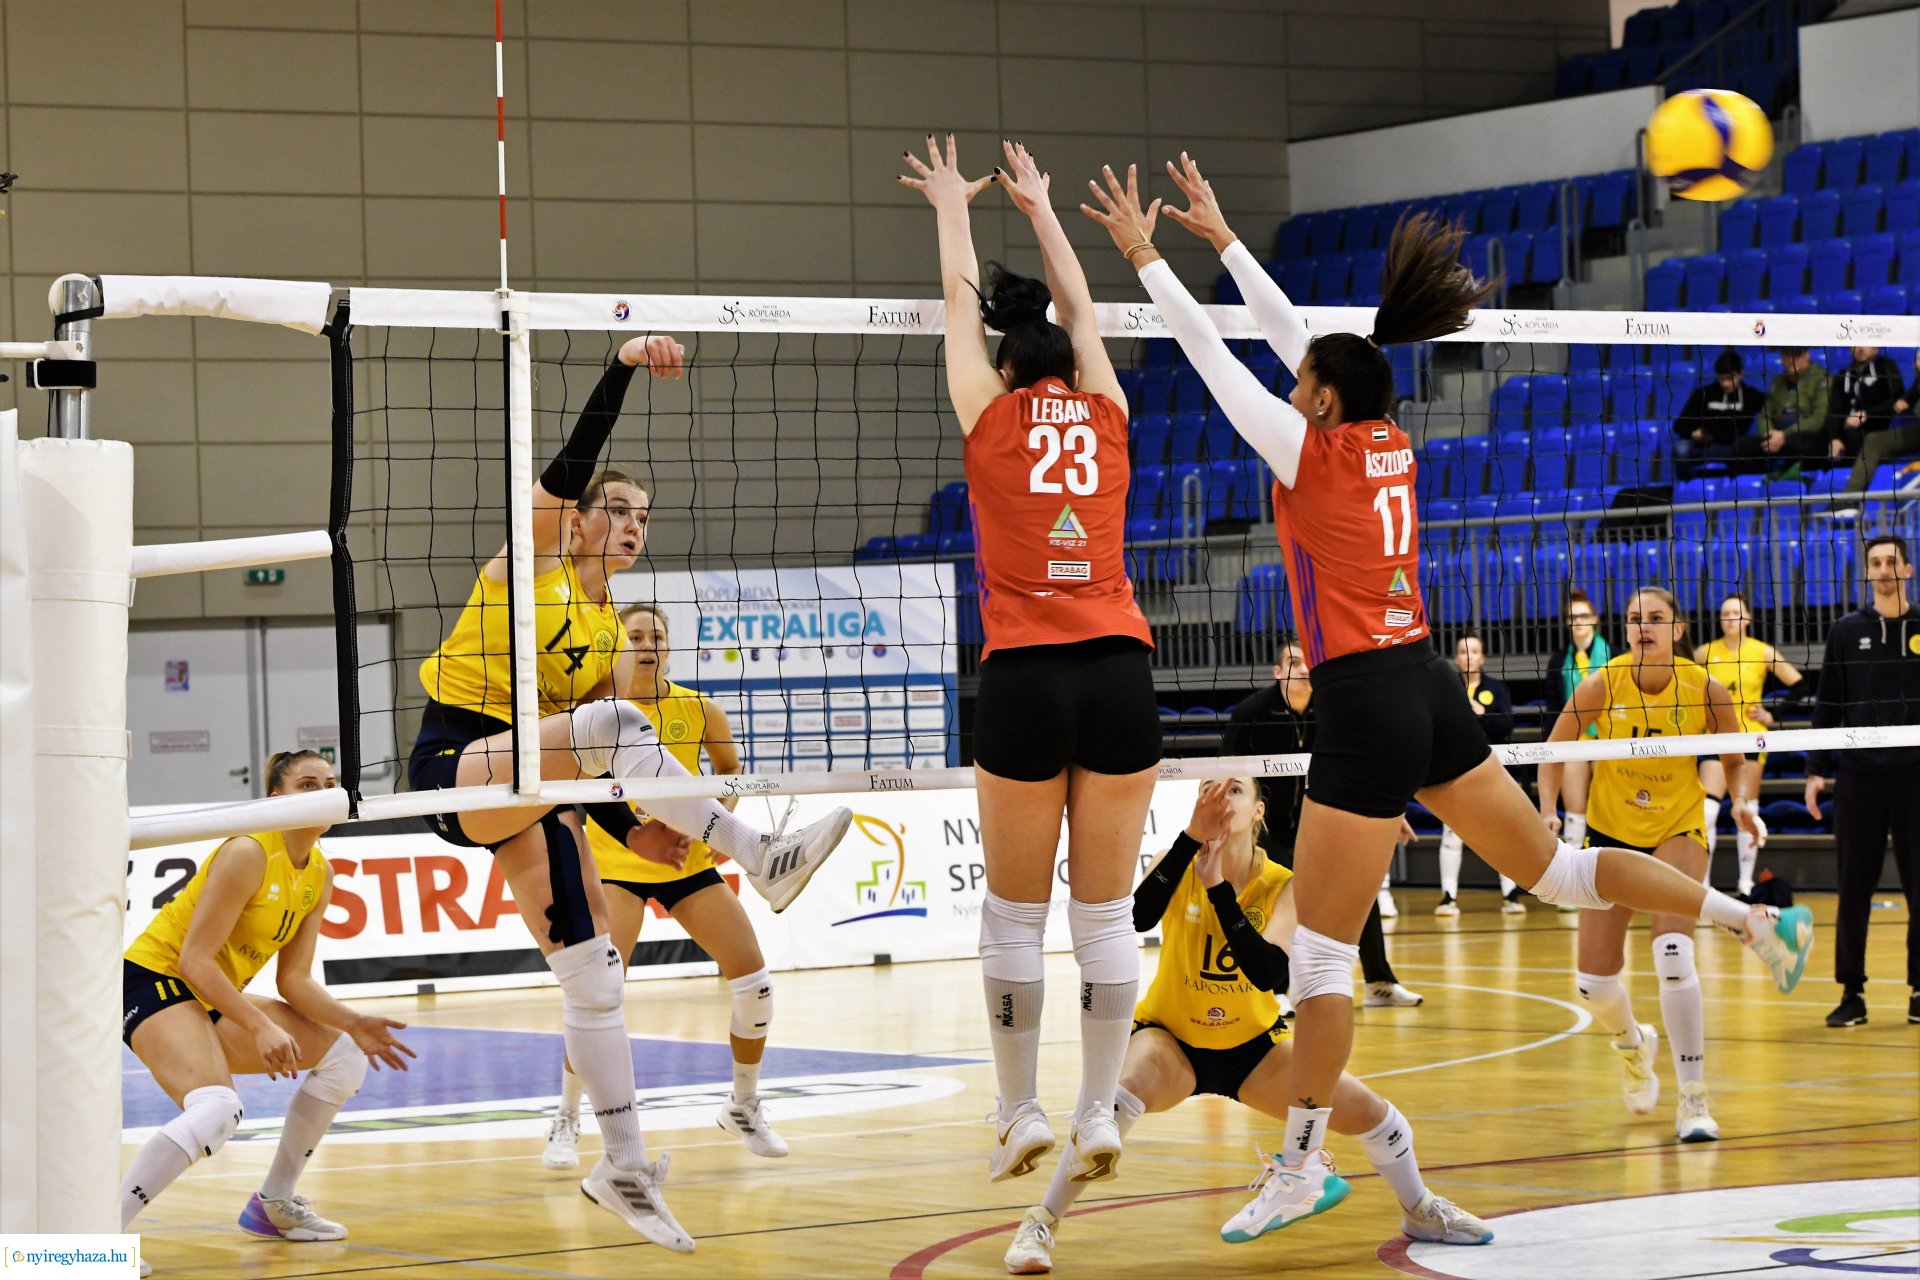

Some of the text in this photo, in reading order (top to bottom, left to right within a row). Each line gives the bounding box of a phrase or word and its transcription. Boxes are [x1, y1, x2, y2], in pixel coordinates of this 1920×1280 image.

[868, 305, 921, 324] FATUM
[1626, 318, 1671, 335] FATUM
[1032, 397, 1091, 424] LEBAN
[1028, 424, 1099, 496] 23
[1373, 484, 1413, 557] 17
[1050, 566, 1088, 574] STRABAG
[697, 611, 886, 642] EXTRALIGA
[545, 617, 591, 676] 14
[869, 774, 915, 791] FATUM
[1263, 759, 1304, 775] FATUM
[271, 909, 296, 943] 11
[1202, 933, 1239, 973] 16
[997, 993, 1015, 1028] MIKASA
[1080, 982, 1094, 1012] MIKAS
[1297, 1119, 1317, 1151] MIKASA
